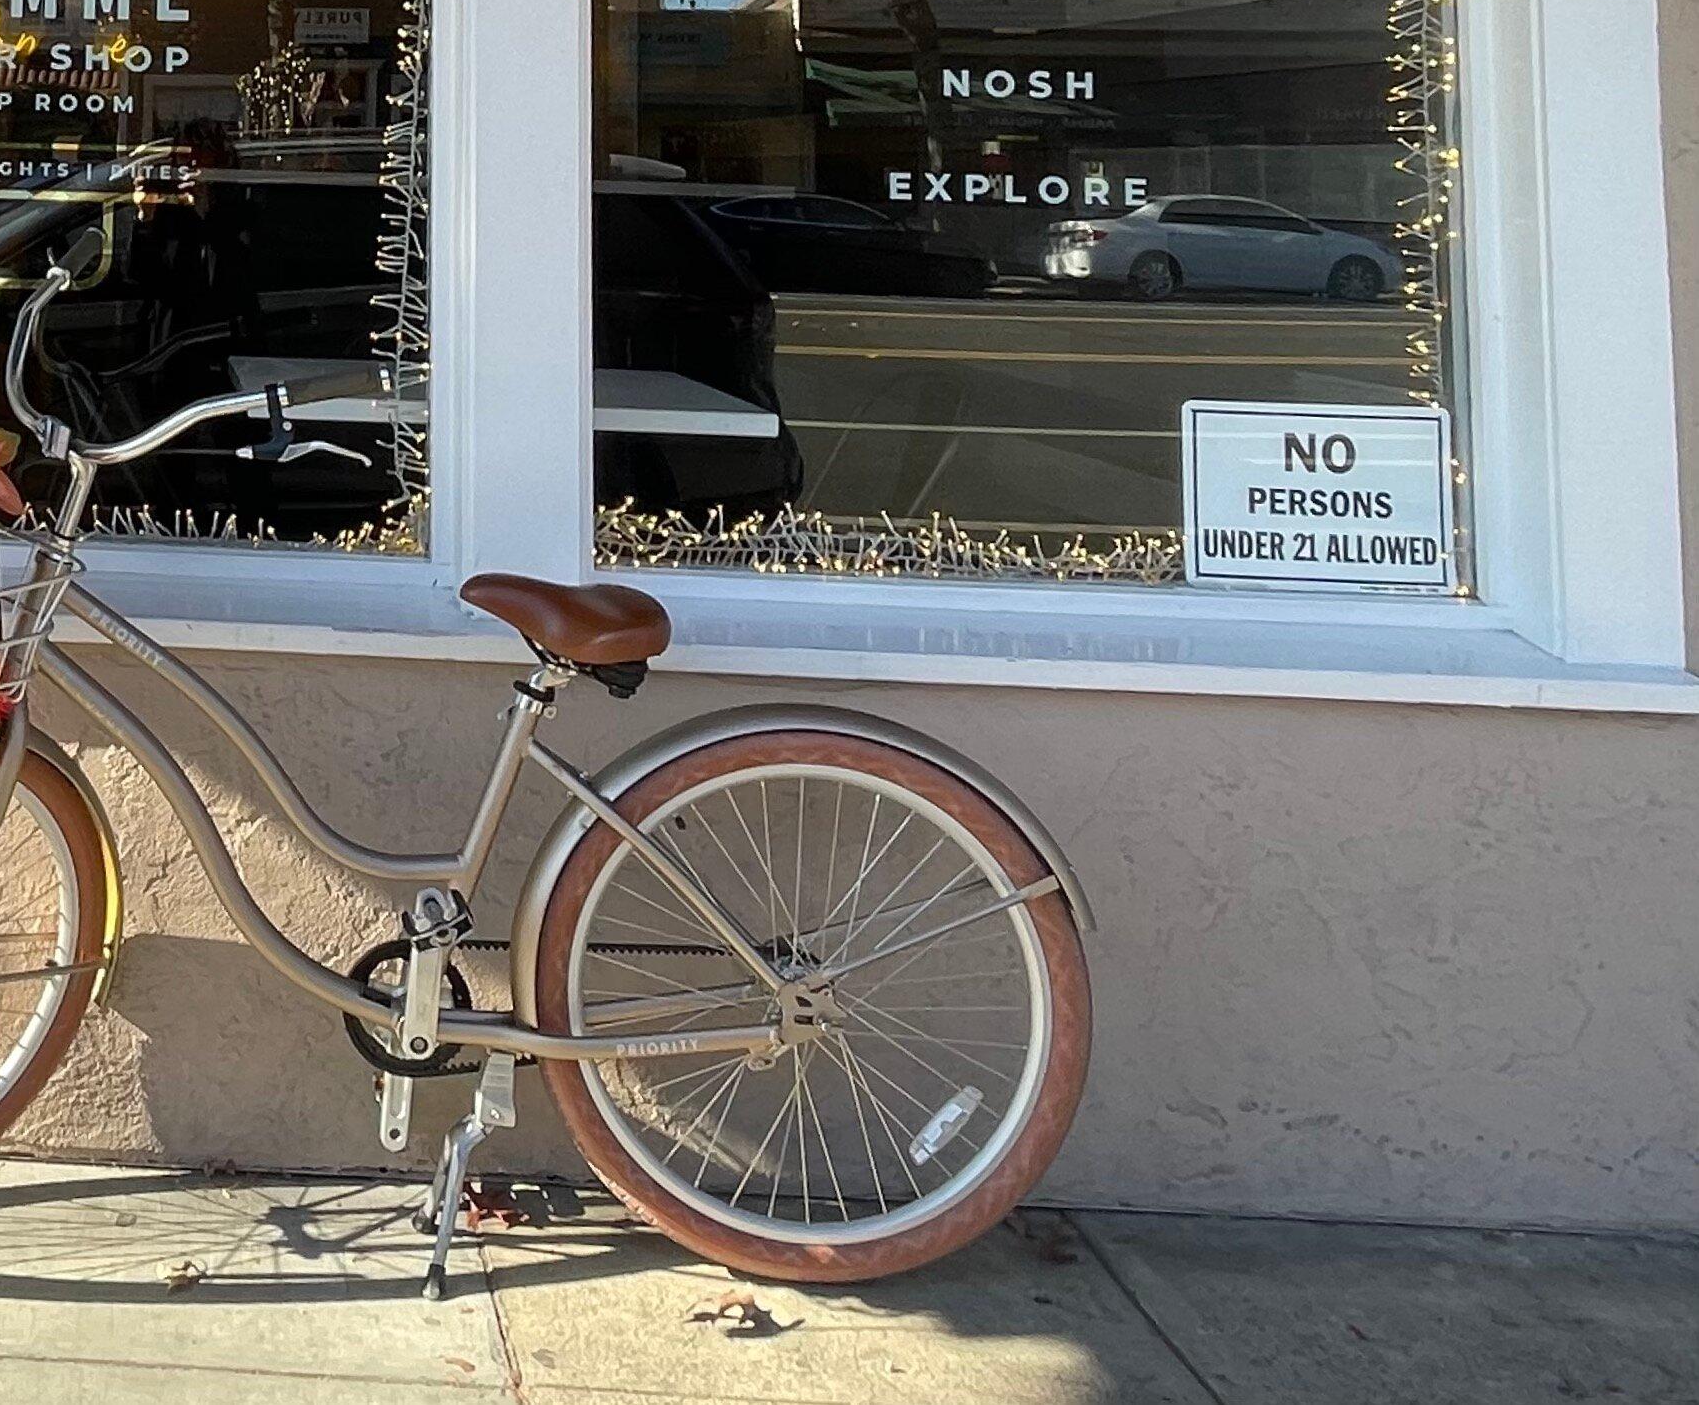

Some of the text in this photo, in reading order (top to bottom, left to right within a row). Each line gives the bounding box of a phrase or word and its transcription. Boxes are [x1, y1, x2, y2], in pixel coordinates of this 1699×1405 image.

[50, 43, 190, 73] SHOP
[942, 69, 1095, 100] NOSH
[35, 93, 134, 114] ROOM
[888, 172, 1148, 206] EXPLORE
[1283, 432, 1357, 474] NO
[1247, 486, 1394, 519] PERSONS
[1202, 528, 1438, 566] UNDER 21 ALLOWED
[89, 607, 163, 667] PRIORITY
[616, 1039, 699, 1056] PRIORITY
